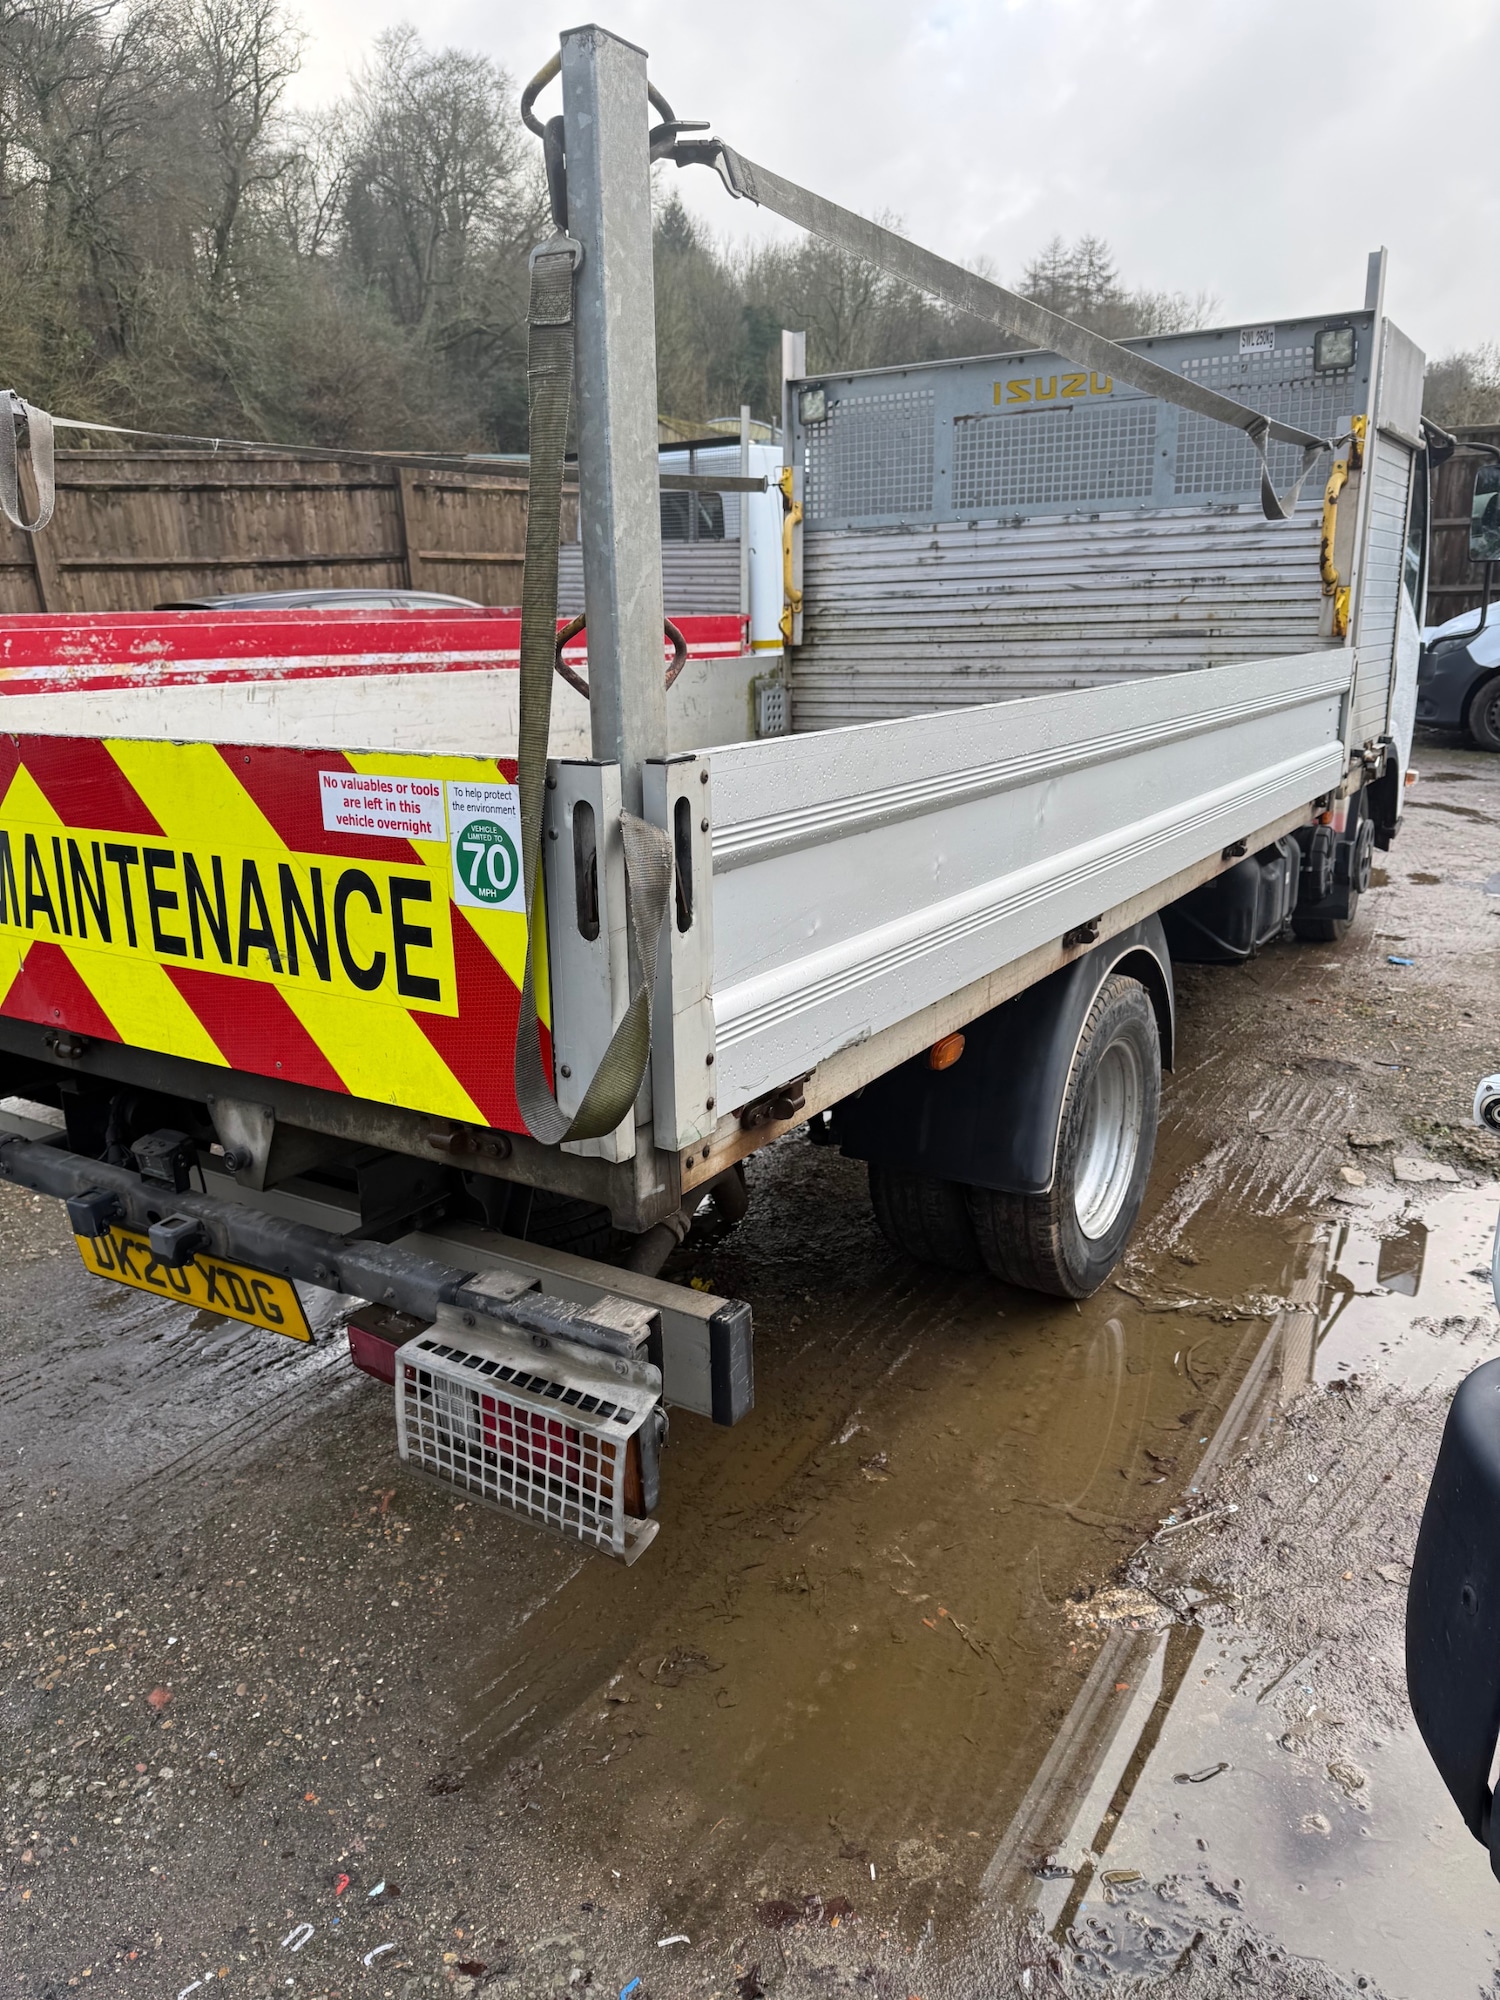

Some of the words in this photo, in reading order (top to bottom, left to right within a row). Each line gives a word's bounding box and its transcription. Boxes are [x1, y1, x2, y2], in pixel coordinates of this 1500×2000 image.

[993, 371, 1113, 405] ISUZU
[323, 775, 338, 789] No
[341, 778, 393, 793] valuables
[396, 783, 408, 794] or
[411, 783, 440, 797] tools
[453, 787, 464, 798] To
[466, 787, 482, 801] help
[484, 790, 513, 803] protect
[343, 798, 361, 809] are
[364, 796, 383, 811] left
[386, 798, 397, 812] in
[399, 799, 421, 814] this
[452, 801, 465, 812] the
[466, 804, 516, 816] environment
[336, 813, 374, 828] vehicle
[377, 818, 432, 835] overnight
[470, 825, 498, 834] VEHICLE
[467, 832, 493, 842] LIMITED
[494, 834, 503, 843] TO
[462, 841, 513, 891] 70
[478, 887, 497, 898] MPH
[193, 1260, 285, 1325] XDG
